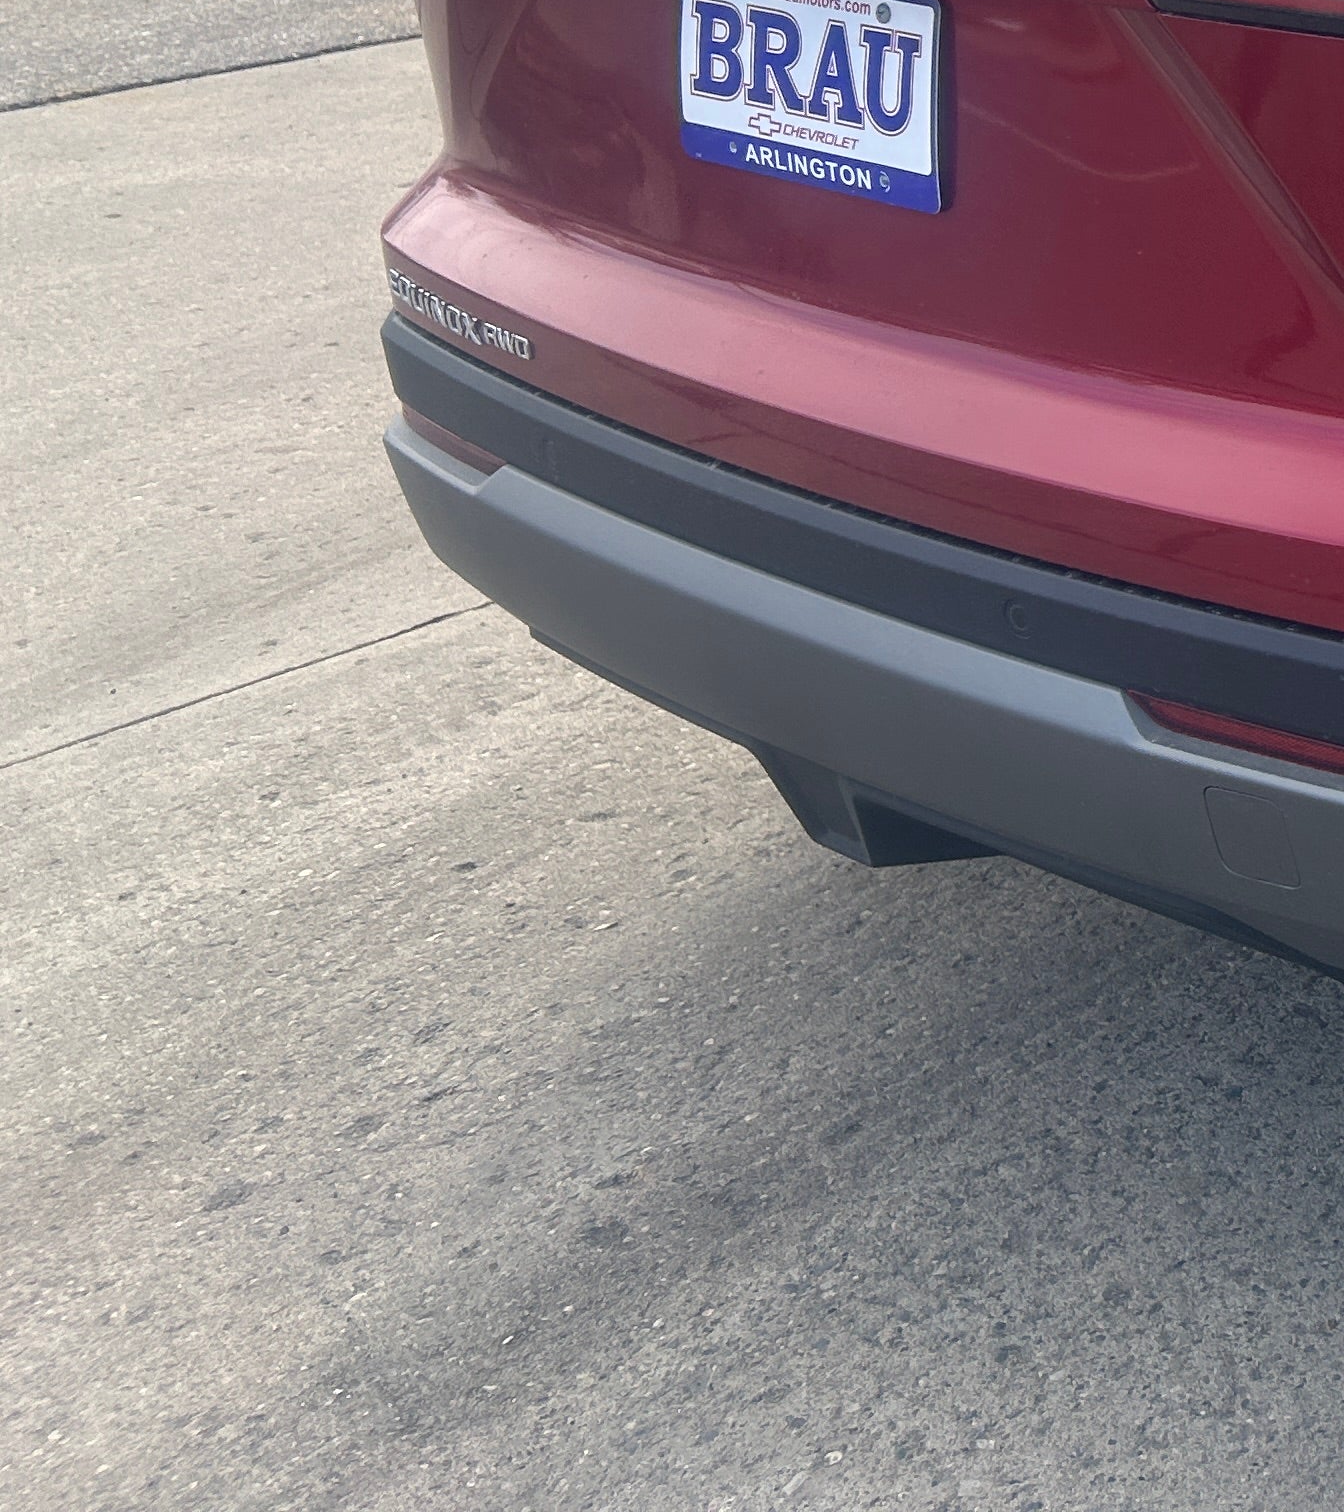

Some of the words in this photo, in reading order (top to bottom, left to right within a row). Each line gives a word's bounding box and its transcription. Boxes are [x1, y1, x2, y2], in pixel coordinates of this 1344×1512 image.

[783, 124, 860, 151] CHEVROLET
[745, 143, 872, 190] ARLINGTON
[389, 268, 482, 346] EQUINOX
[482, 322, 534, 360] AWD
